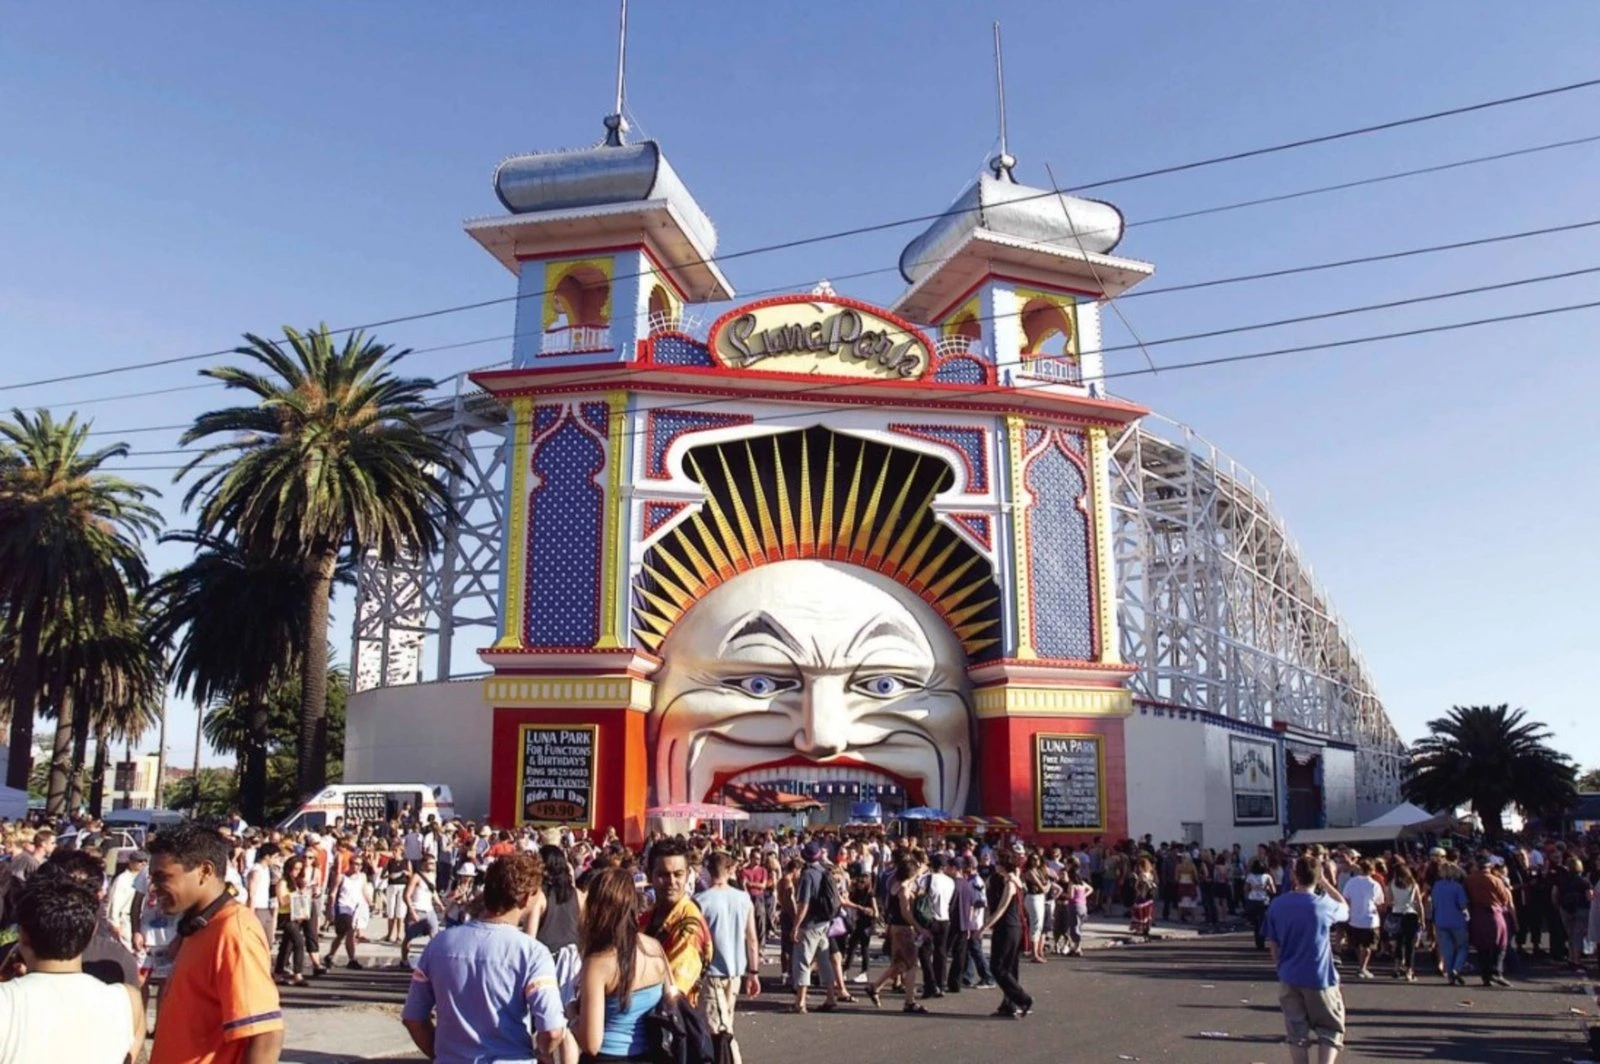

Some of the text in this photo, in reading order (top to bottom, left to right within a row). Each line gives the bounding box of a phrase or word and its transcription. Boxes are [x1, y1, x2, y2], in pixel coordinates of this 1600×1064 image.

[728, 309, 921, 378] Luna Park
[527, 730, 591, 744] LUNA PARK
[526, 744, 592, 757] FOR FUNCTIONS
[1040, 739, 1096, 753] LUNA PARK
[529, 755, 587, 766] & BIRTHDAYS
[550, 788, 565, 800] All
[568, 790, 586, 807] Day
